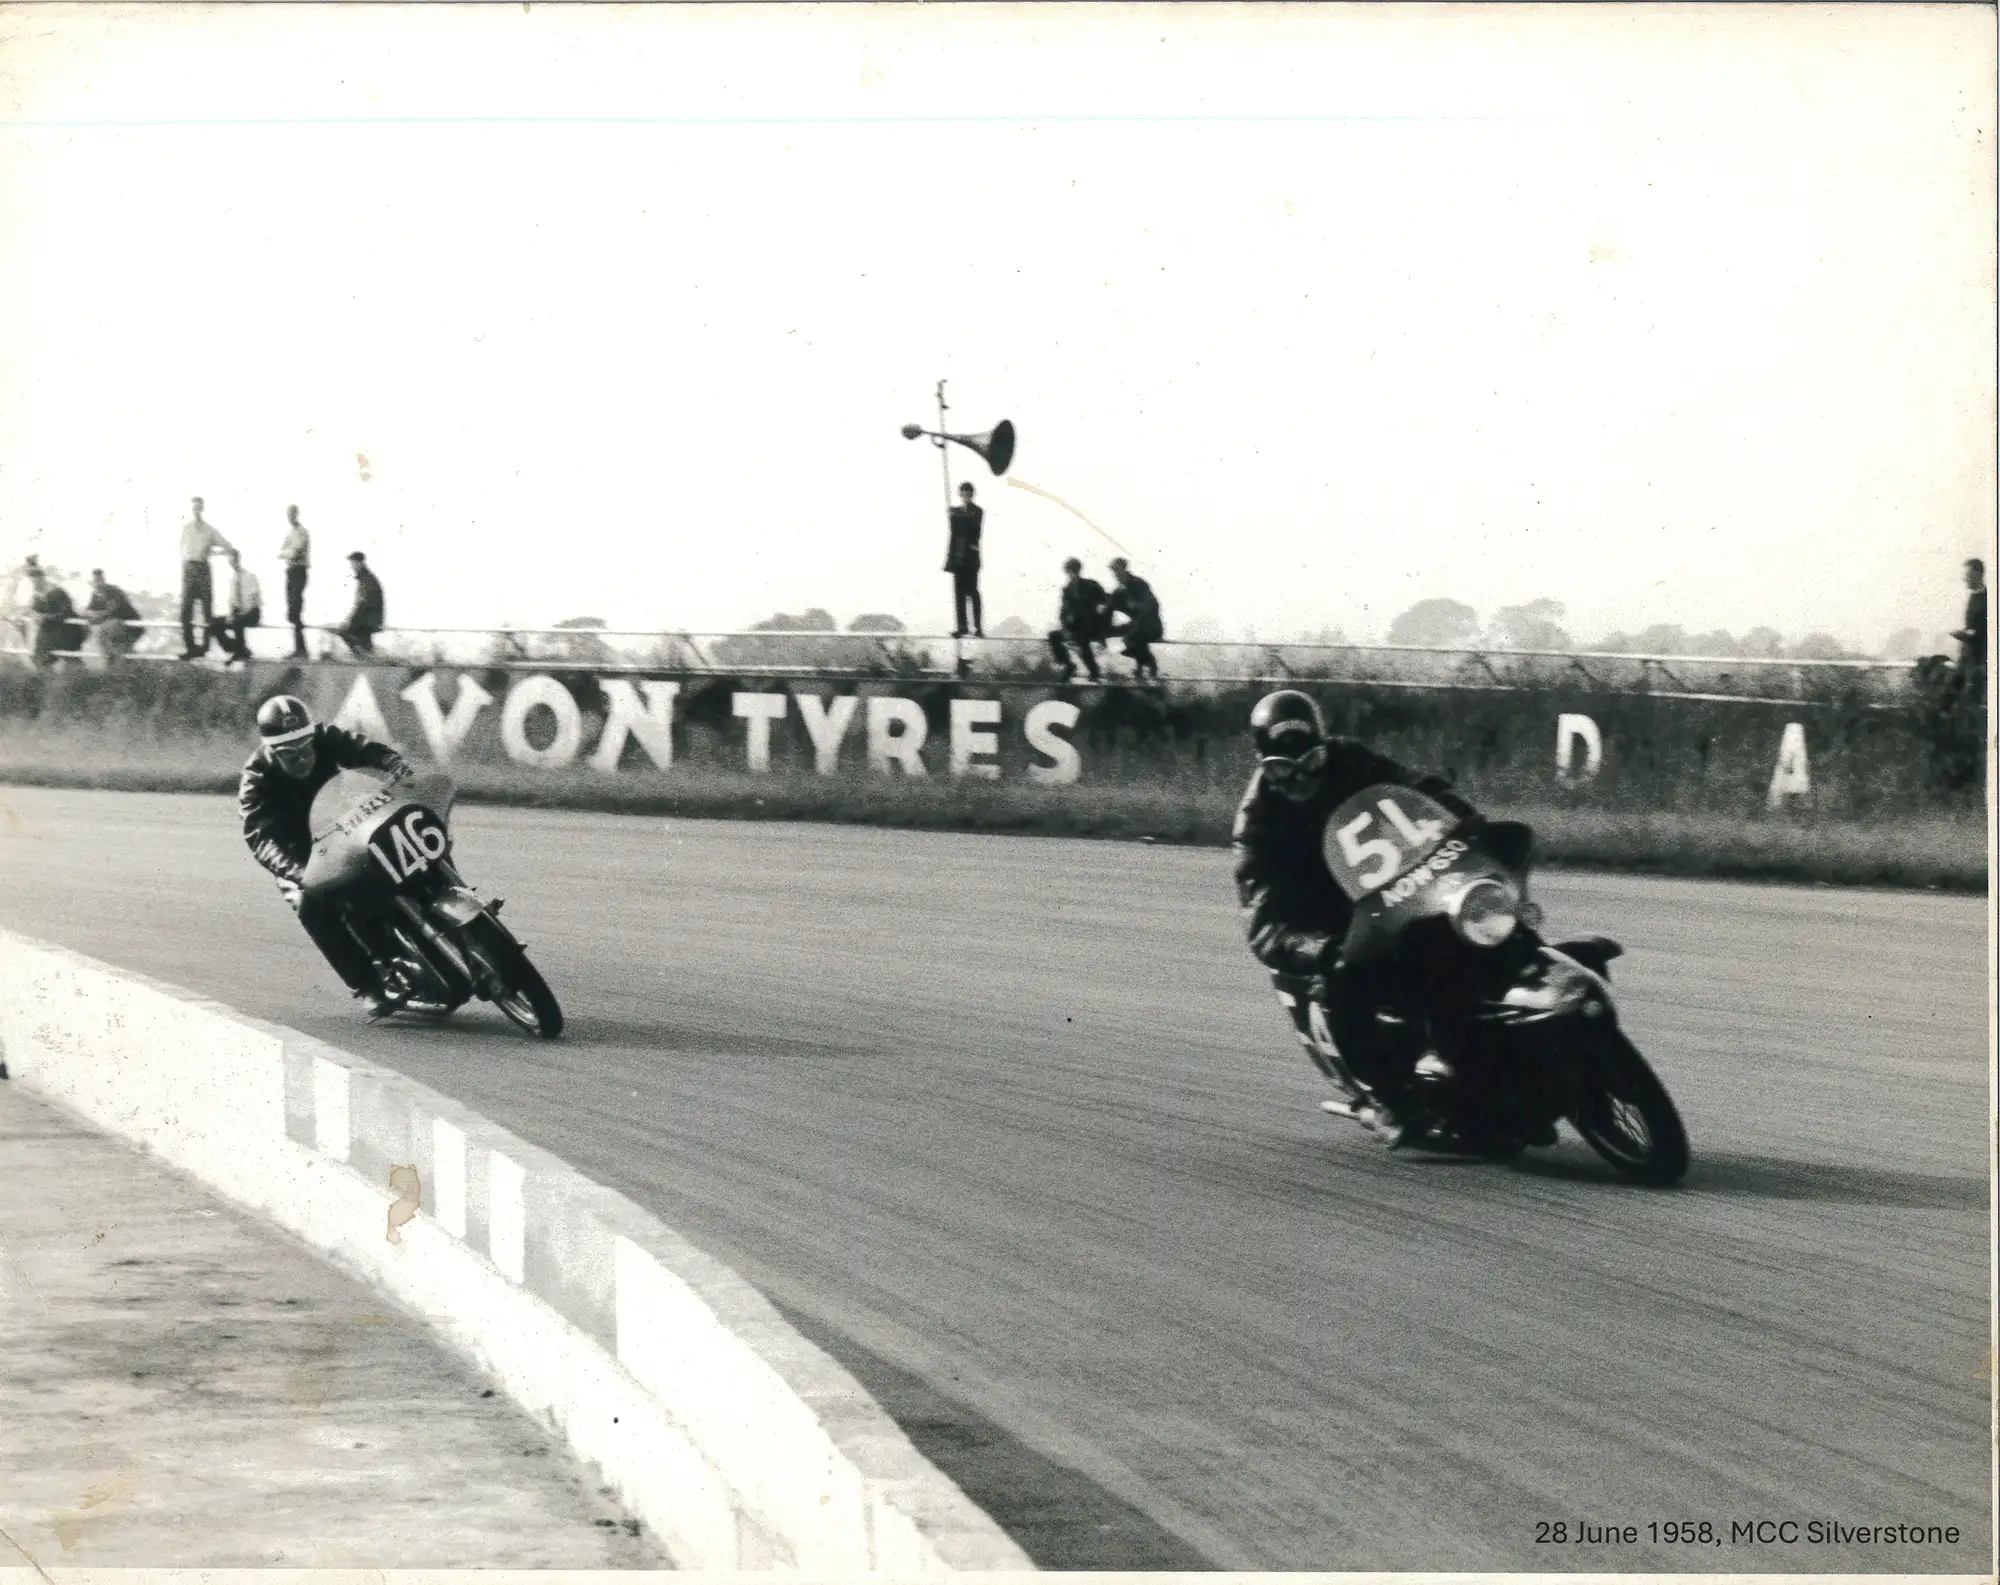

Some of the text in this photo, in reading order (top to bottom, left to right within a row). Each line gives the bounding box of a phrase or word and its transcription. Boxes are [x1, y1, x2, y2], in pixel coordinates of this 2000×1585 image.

[333, 673, 1082, 786] AVON TYRES
[1555, 712, 1810, 810] D A
[368, 810, 446, 884] 146
[1336, 798, 1443, 889] 54
